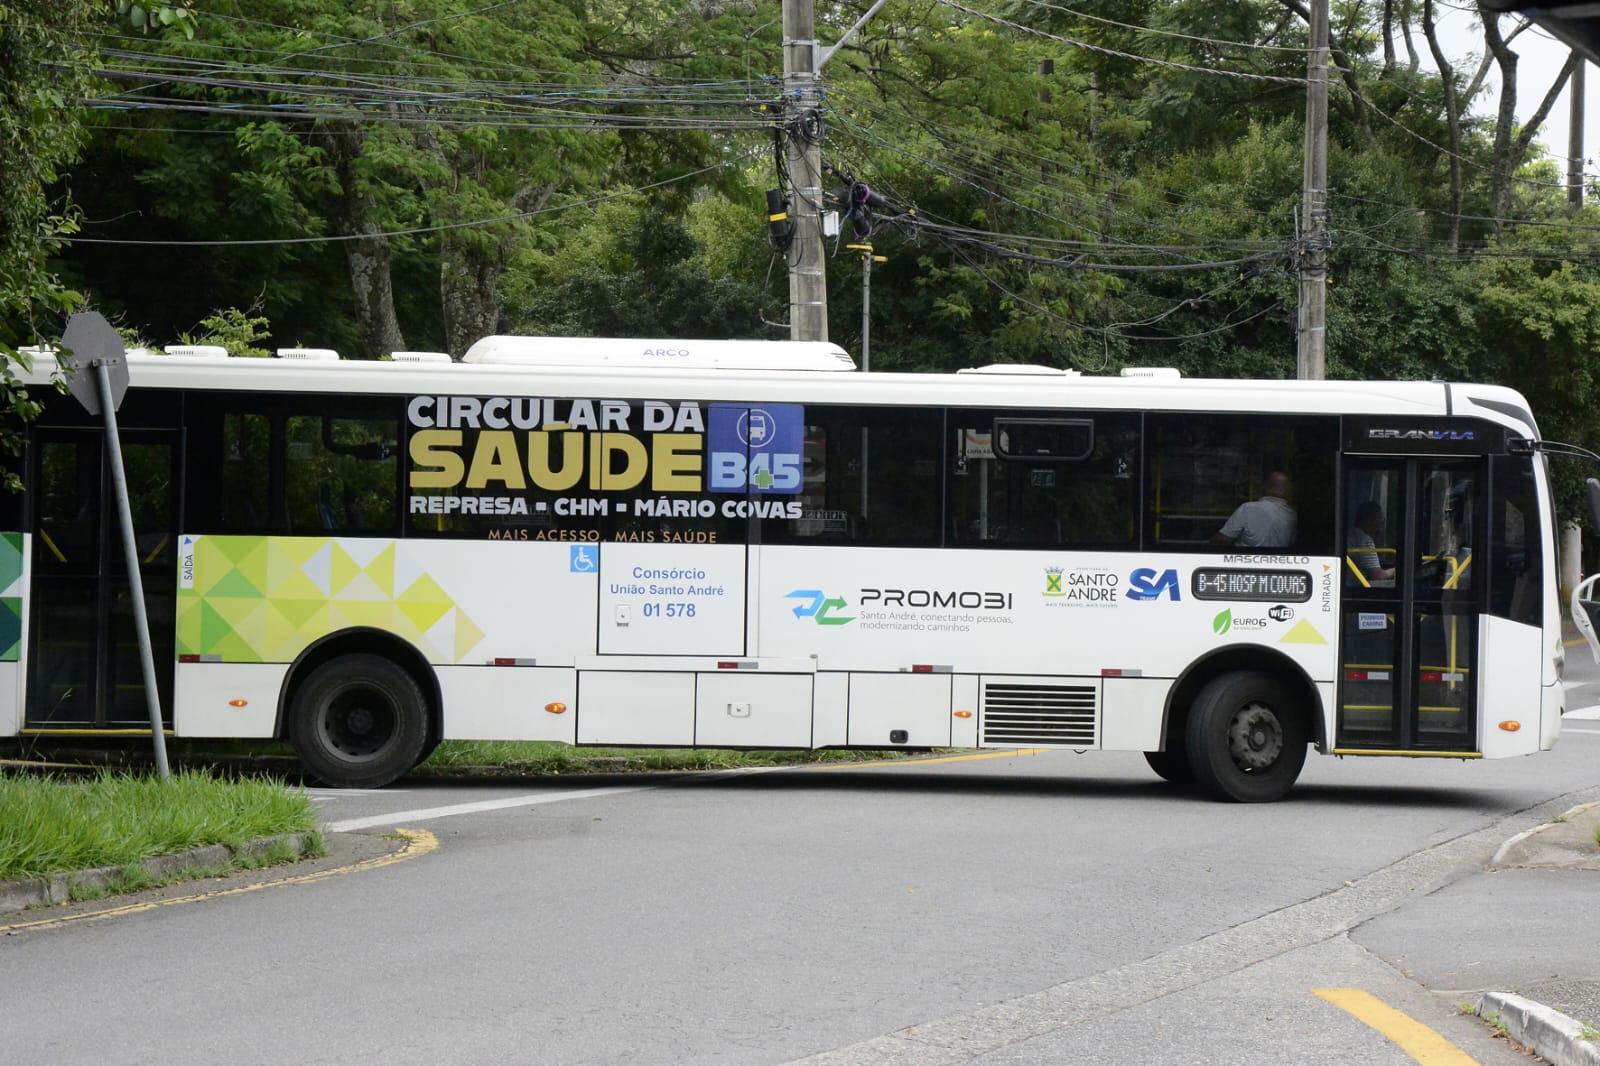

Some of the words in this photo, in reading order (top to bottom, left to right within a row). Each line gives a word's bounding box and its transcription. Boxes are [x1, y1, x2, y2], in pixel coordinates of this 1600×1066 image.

[643, 349, 690, 357] ARCO
[407, 396, 631, 431] CIRCULAR
[643, 401, 705, 432] DA
[409, 422, 703, 492] SAÚDE
[711, 452, 801, 489] B45
[409, 496, 528, 515] REPRESA
[554, 498, 608, 517] CHM
[634, 496, 716, 518] MÁRIO
[721, 500, 803, 519] COVAS
[488, 529, 528, 541] MAIS
[615, 531, 655, 543] MAIS
[662, 528, 717, 544] SAÚDE
[181, 554, 193, 581] SAÍDA
[1223, 555, 1310, 565] MASCARELLO
[632, 566, 706, 580] Consórcio
[1068, 573, 1119, 587] SANTO
[610, 584, 646, 595] União
[649, 585, 685, 596] Santo
[687, 585, 724, 596] André
[1198, 574, 1227, 592] B-45
[1229, 575, 1257, 593] HOSP
[1259, 575, 1268, 593] M
[1270, 576, 1307, 594] COVAS
[860, 589, 1012, 610] PROMOBI
[1067, 587, 1117, 602] ANDRÉ
[1322, 573, 1331, 613] ENTRADA
[666, 604, 696, 617] 578
[860, 611, 887, 621] Santo
[889, 612, 918, 622] André,
[920, 614, 975, 624] conectando
[976, 616, 1014, 625] pessoas,
[860, 622, 926, 632] modernizando
[927, 623, 971, 633] caminhos
